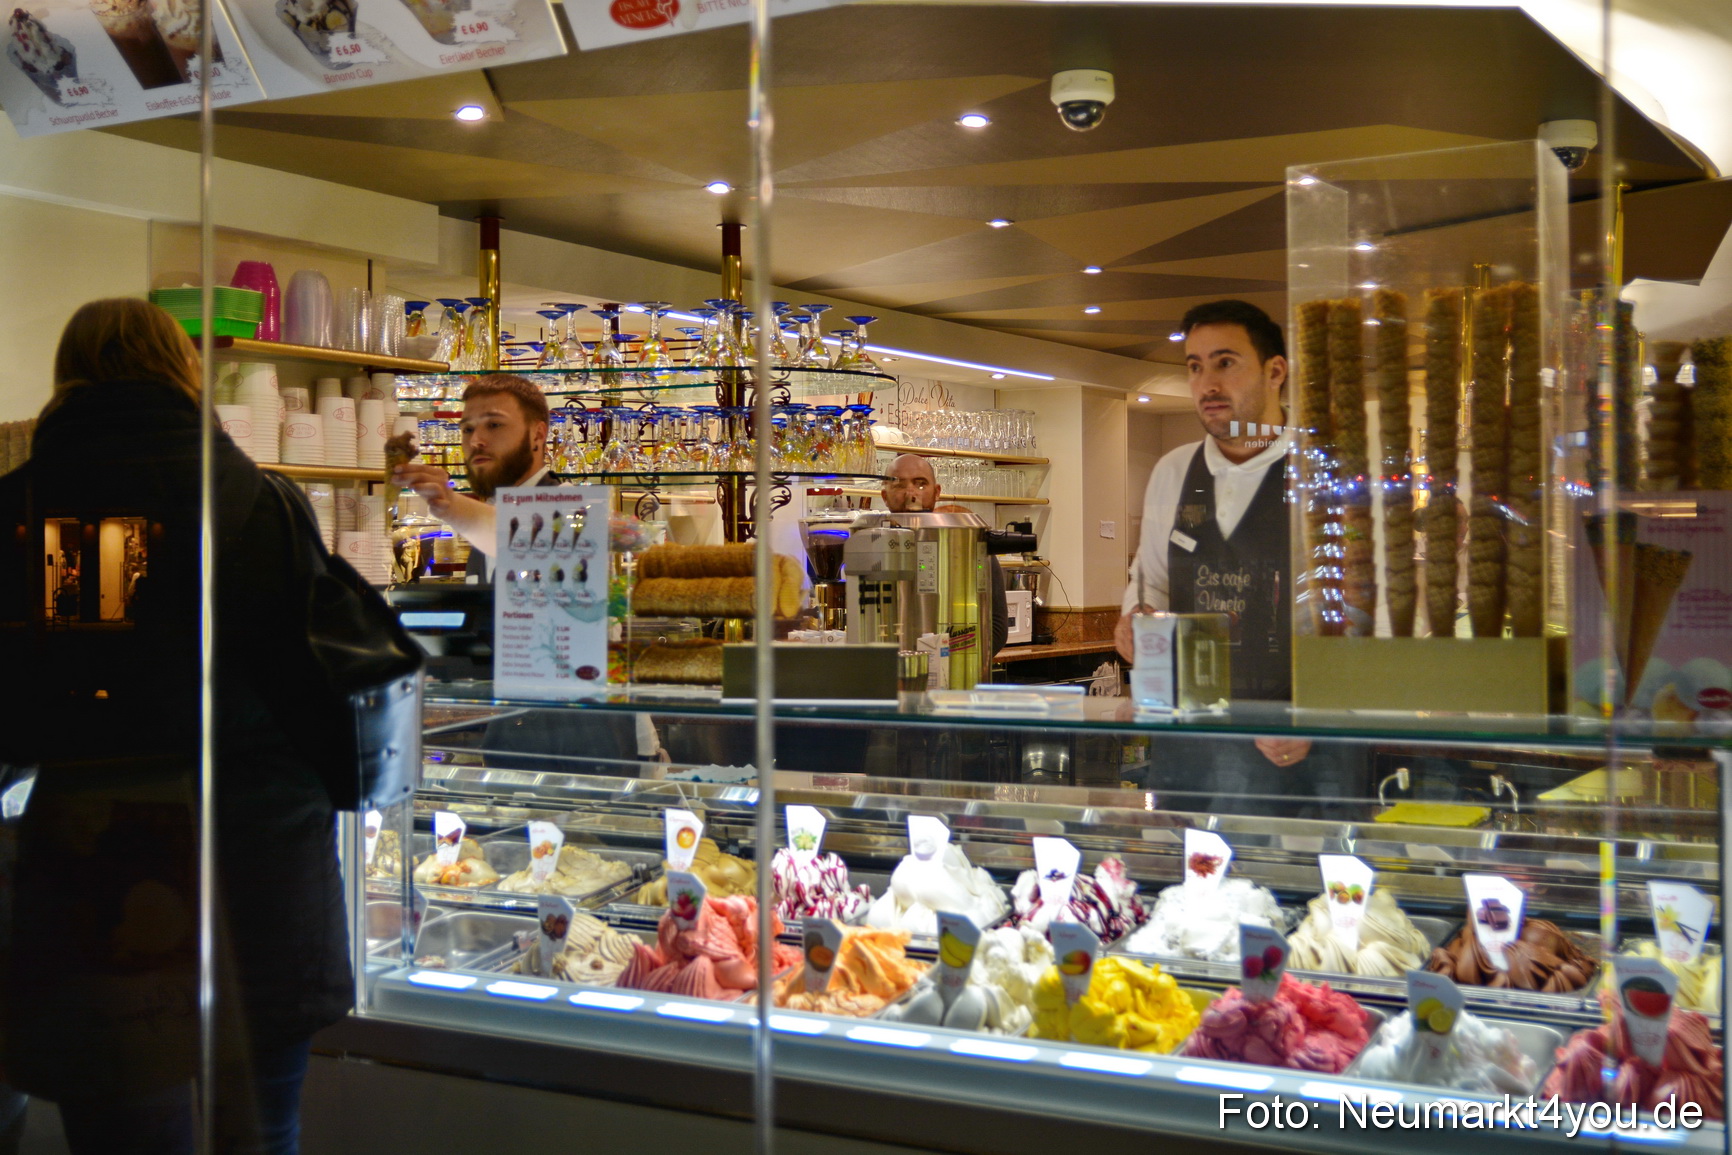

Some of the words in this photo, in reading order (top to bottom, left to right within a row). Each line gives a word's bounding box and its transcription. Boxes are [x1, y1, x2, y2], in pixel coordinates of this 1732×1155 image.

[469, 21, 489, 35] 6,90
[342, 43, 361, 56] 6,50
[439, 51, 474, 65] Eierlikör
[476, 45, 506, 60] Becher
[323, 69, 355, 84] Banana
[356, 68, 374, 81] Cup
[95, 109, 118, 120] Becher
[898, 381, 929, 407] Dolce
[930, 384, 957, 409] Vita
[502, 493, 515, 503] Eis
[535, 492, 583, 503] Mitnehmen
[1196, 564, 1220, 587] Eis
[1197, 589, 1247, 612] Veneto
